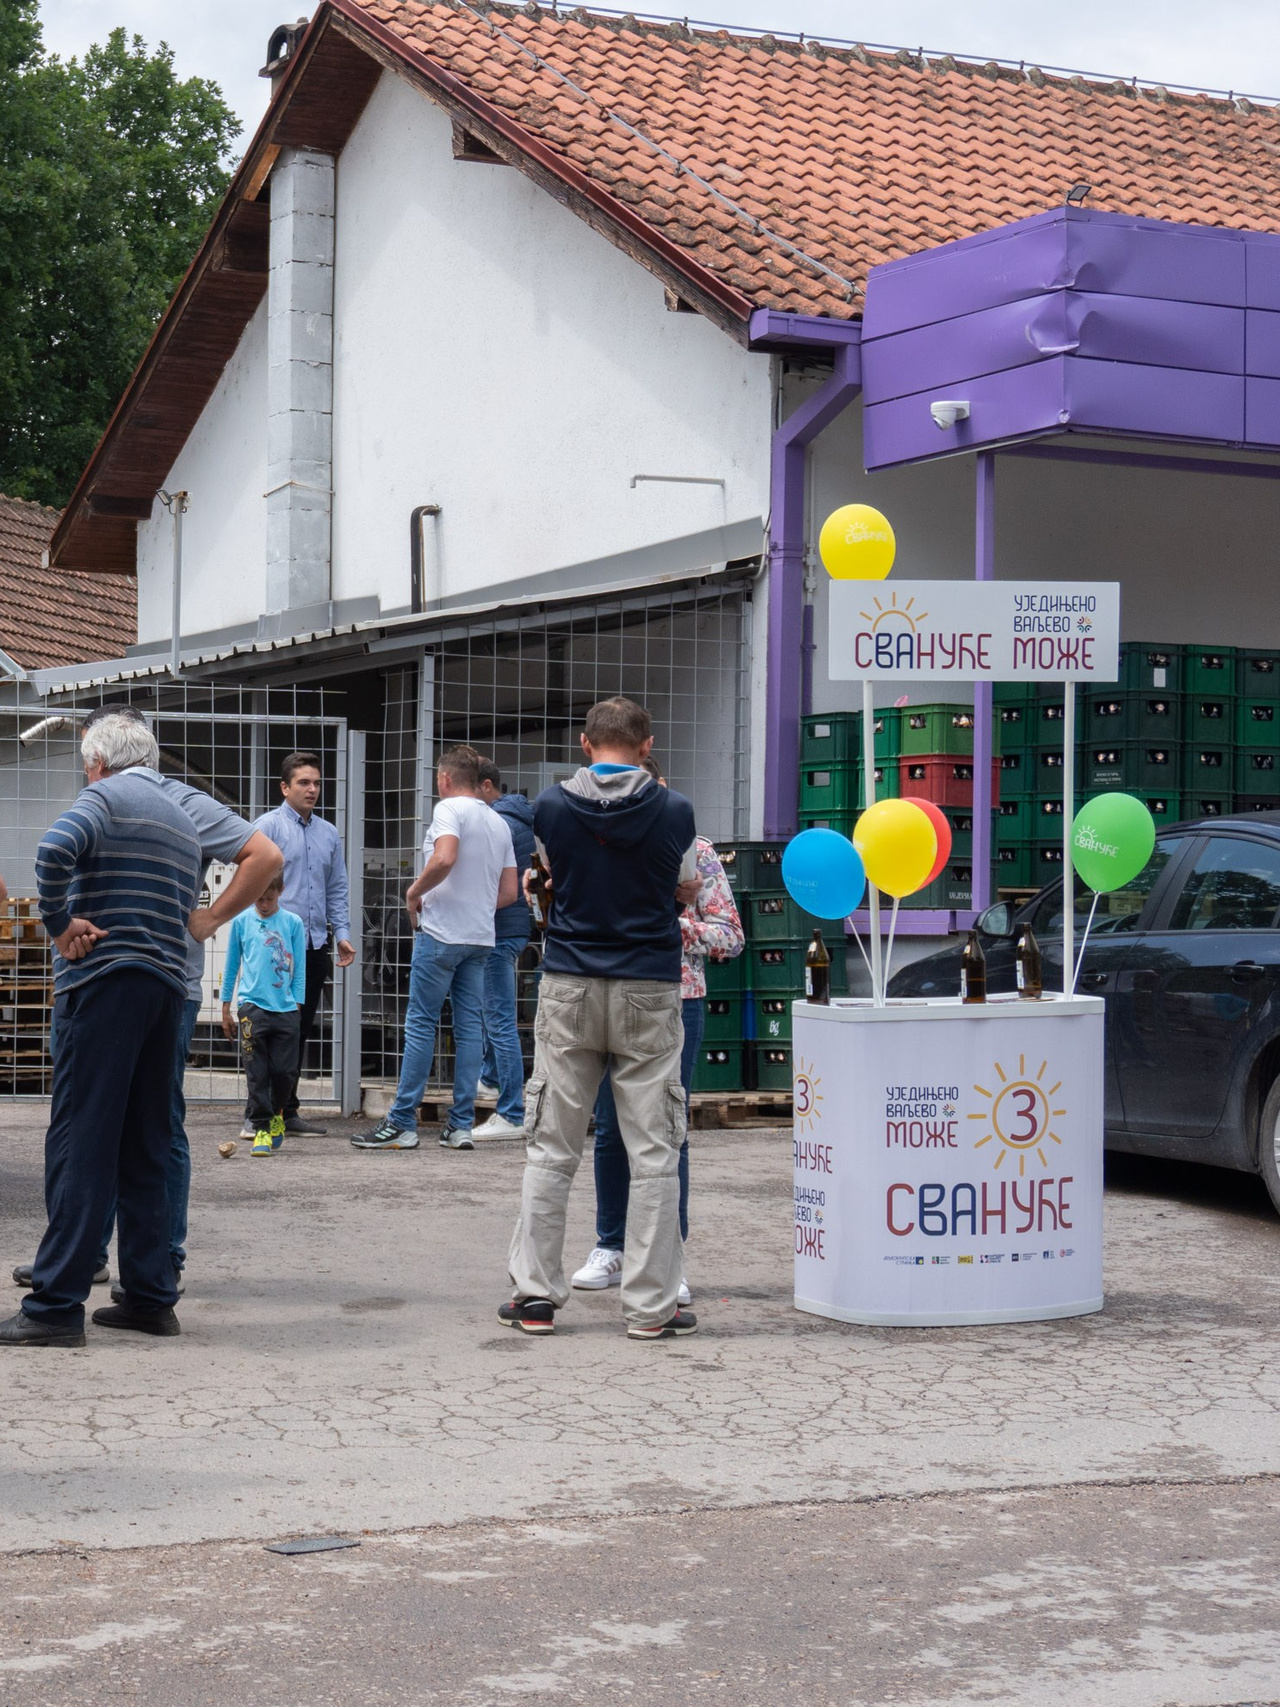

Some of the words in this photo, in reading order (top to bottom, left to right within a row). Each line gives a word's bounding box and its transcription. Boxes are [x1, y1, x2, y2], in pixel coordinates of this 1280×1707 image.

[1014, 595, 1096, 613] УЈЕДИЊЕНО
[1013, 616, 1071, 633] ВАЉЕВО
[854, 632, 992, 670] СВАНУЋЕ
[1013, 637, 1096, 670] МОЖЕ
[797, 1078, 809, 1112] 3
[886, 1086, 959, 1102] УЈЕДИЊЕНО
[886, 1104, 937, 1118] ВАЉЕВО
[1010, 1089, 1038, 1142] 3
[886, 1121, 959, 1148] МОЖЕ
[886, 1176, 1074, 1237] СВАНУЋЕ
[795, 1224, 826, 1261] ОЖЕ
